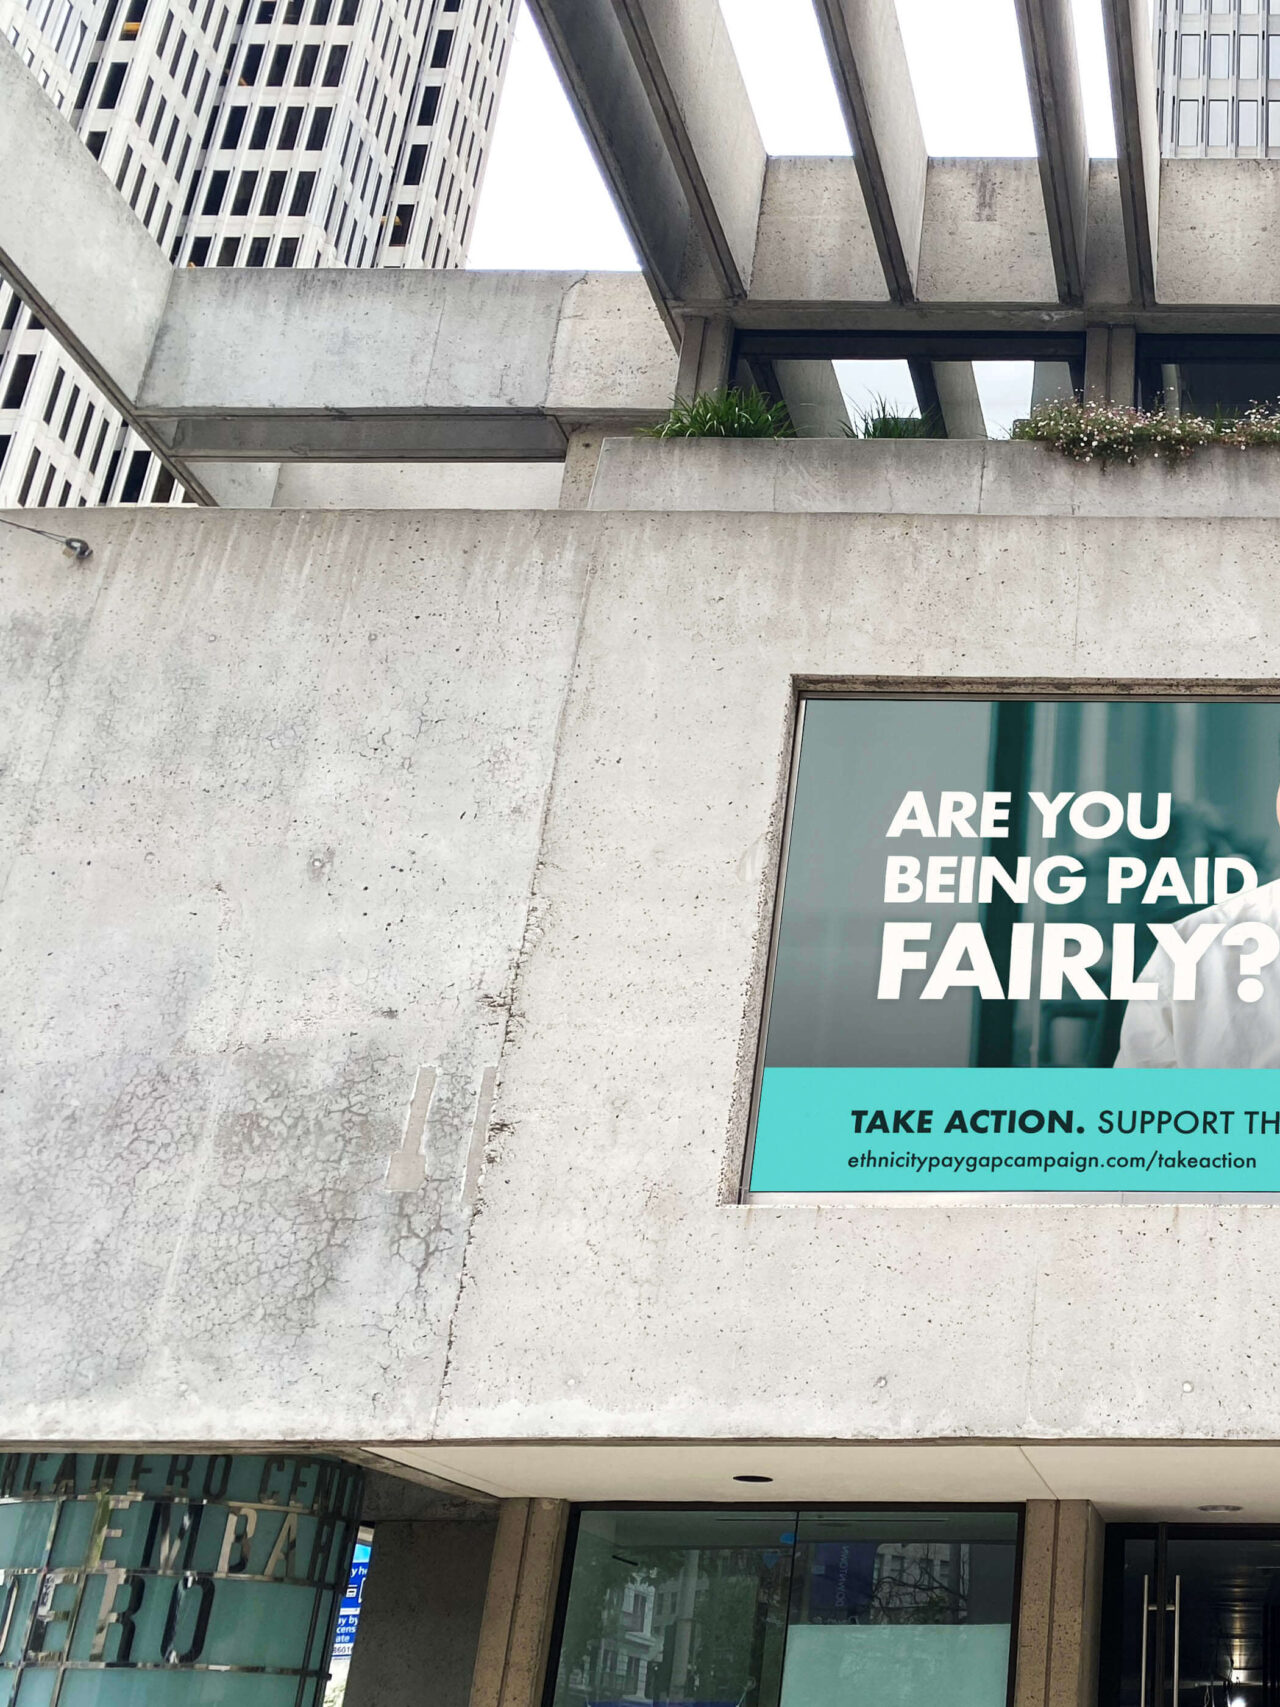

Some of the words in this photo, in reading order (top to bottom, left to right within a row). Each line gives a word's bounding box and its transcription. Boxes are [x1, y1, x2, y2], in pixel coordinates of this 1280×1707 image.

[885, 791, 1011, 838] ARE
[1029, 790, 1172, 840] YOU
[884, 855, 1087, 905] BEING
[1107, 857, 1258, 905] PAID
[877, 922, 1280, 1003] FAIRLY?
[851, 1109, 934, 1134] TAKE
[943, 1109, 1085, 1135] ACTION.
[1097, 1110, 1235, 1135] SUPPORT
[848, 1149, 1257, 1173] ethnicitypaygapcampaign.com/takeaction
